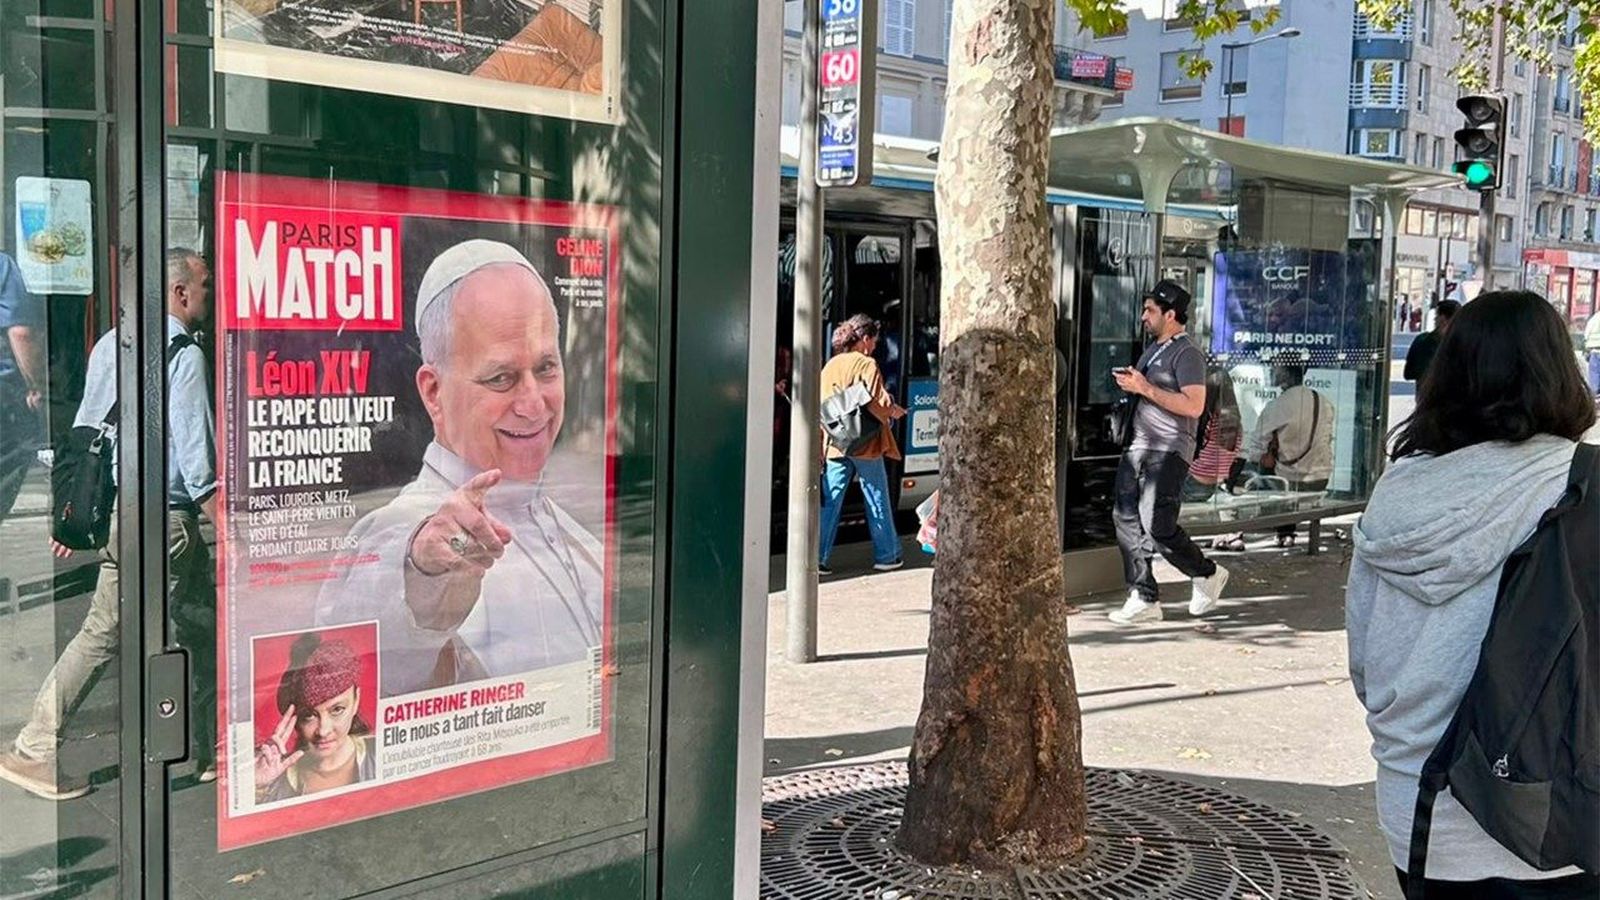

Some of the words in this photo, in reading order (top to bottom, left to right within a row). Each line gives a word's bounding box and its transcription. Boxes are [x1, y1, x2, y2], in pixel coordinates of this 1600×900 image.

[826, 53, 854, 81] 60
[281, 221, 357, 247] PARIS
[235, 218, 394, 321] MATCH
[570, 256, 603, 278] DION
[1262, 265, 1310, 280] CCF
[1234, 331, 1273, 343] PARIS
[1275, 332, 1293, 344] NE
[1295, 333, 1334, 345] DORT
[247, 350, 316, 396] Léon
[320, 350, 371, 395] XIV
[1304, 376, 1331, 389] oine
[248, 400, 268, 427] LE
[271, 398, 317, 426] PAPE
[319, 397, 351, 425] QUI
[352, 396, 395, 423] VEUT
[248, 425, 372, 458] RECONQUÉRIR
[248, 461, 272, 488] LA
[274, 457, 343, 487] FRANCE
[248, 494, 279, 510] PARIS,
[280, 491, 323, 508] LOURDES,
[249, 511, 260, 526] LE
[316, 505, 342, 520] VIENT
[344, 504, 356, 518] EN
[249, 526, 278, 542] VISITE
[249, 542, 292, 558] PENDANT
[294, 538, 328, 554] QUATRE
[330, 534, 358, 551] JOURS
[384, 690, 468, 725] CATHERINE
[470, 681, 525, 707] RINGER
[383, 726, 407, 747] Elle
[410, 721, 440, 742] nous
[442, 719, 450, 734] a
[453, 710, 479, 732] tant
[481, 706, 503, 726] fait
[506, 701, 546, 721] danser
